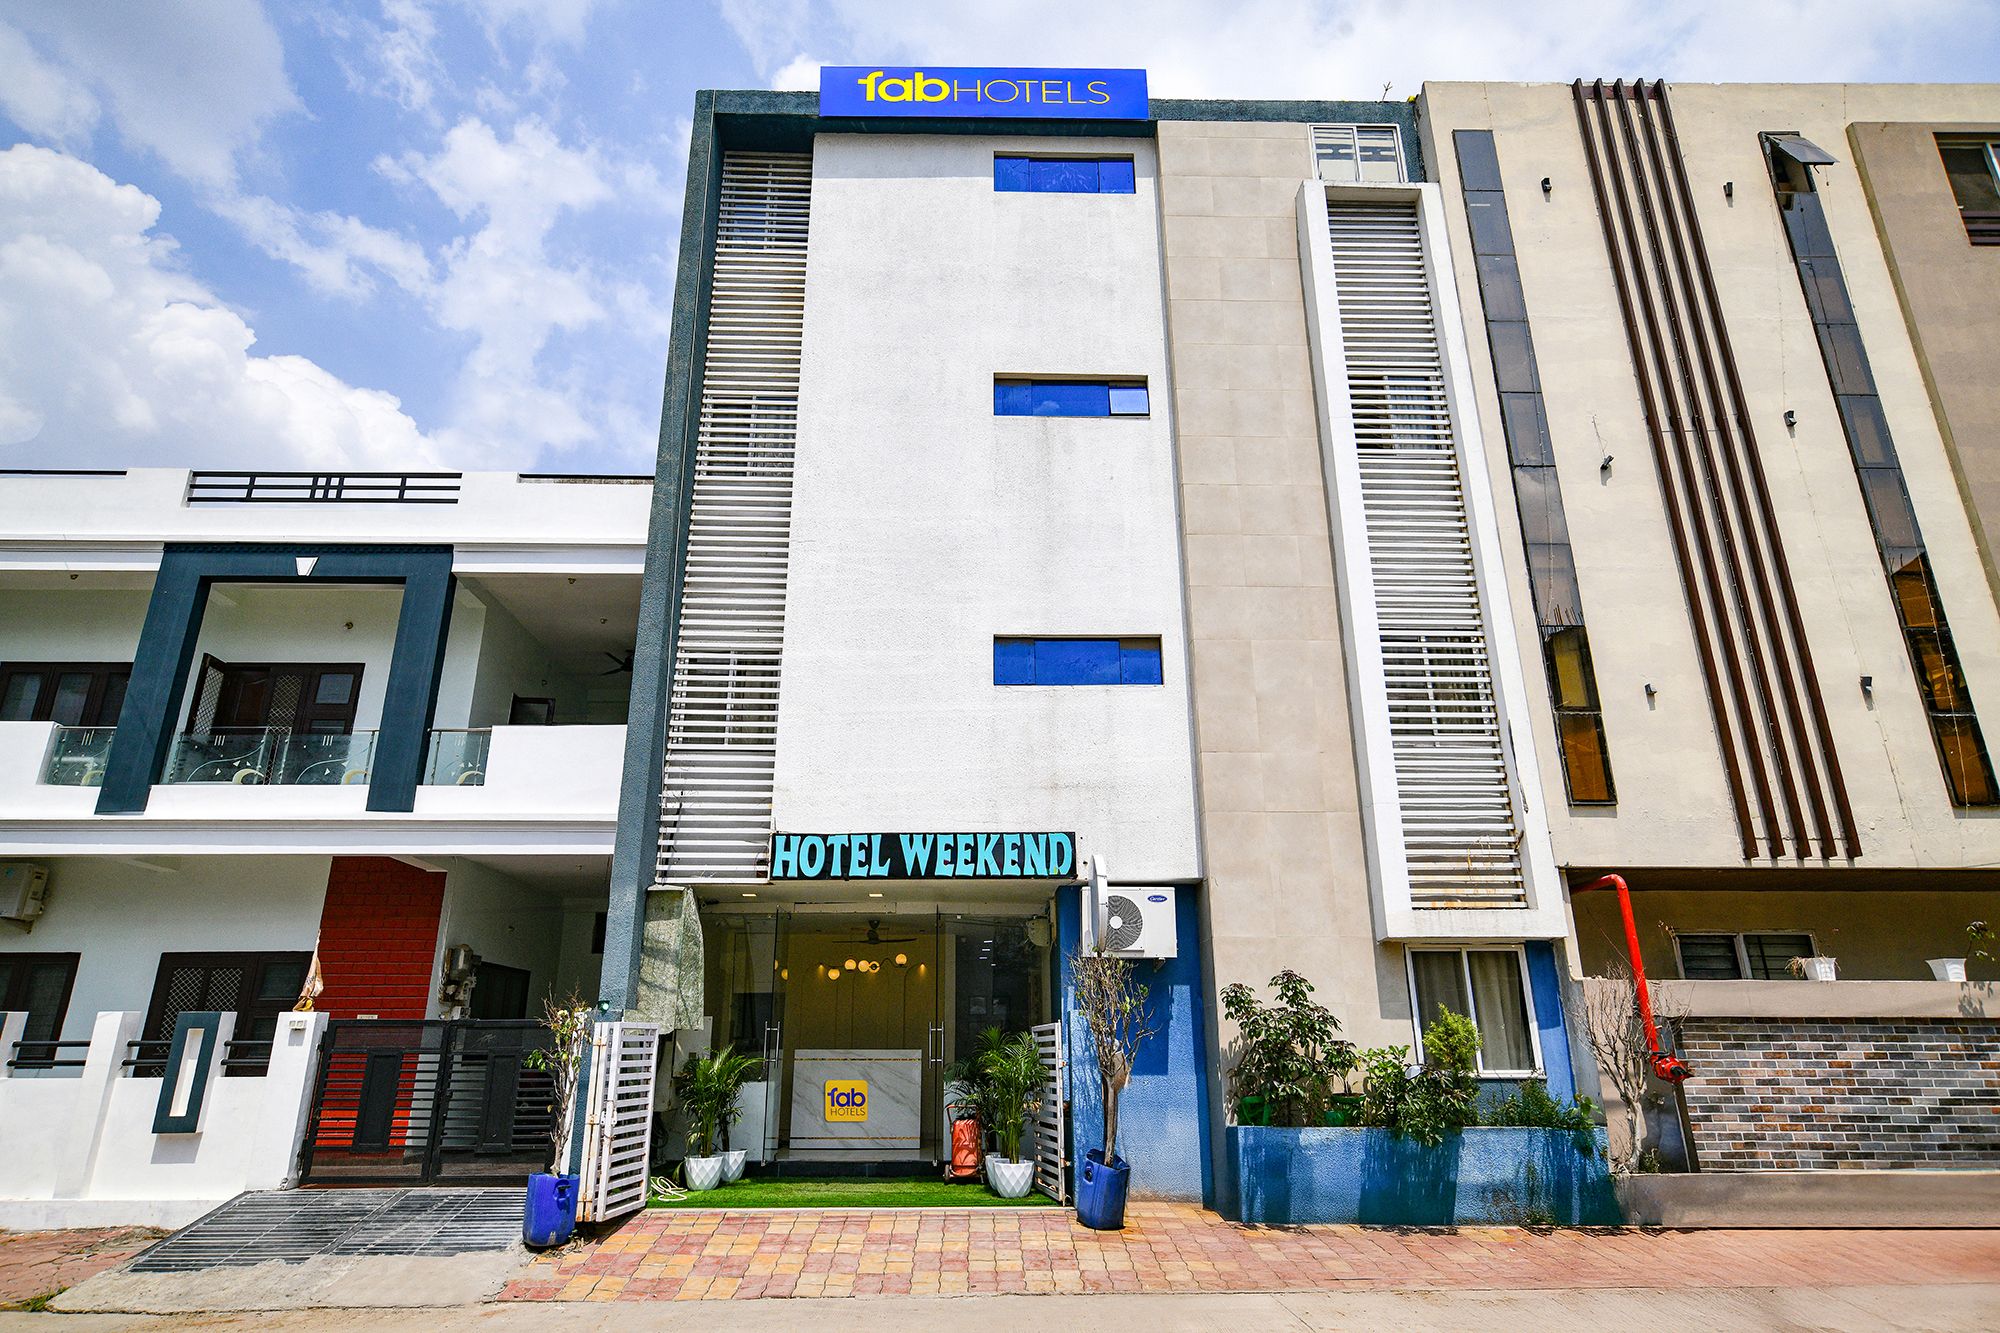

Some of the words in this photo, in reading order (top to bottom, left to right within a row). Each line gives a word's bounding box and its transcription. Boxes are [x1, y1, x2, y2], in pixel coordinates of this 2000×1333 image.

[772, 834, 891, 878] HOTEL
[899, 832, 1073, 877] WEEKEND
[827, 1087, 866, 1107] fab
[830, 1107, 866, 1117] HOTELS
